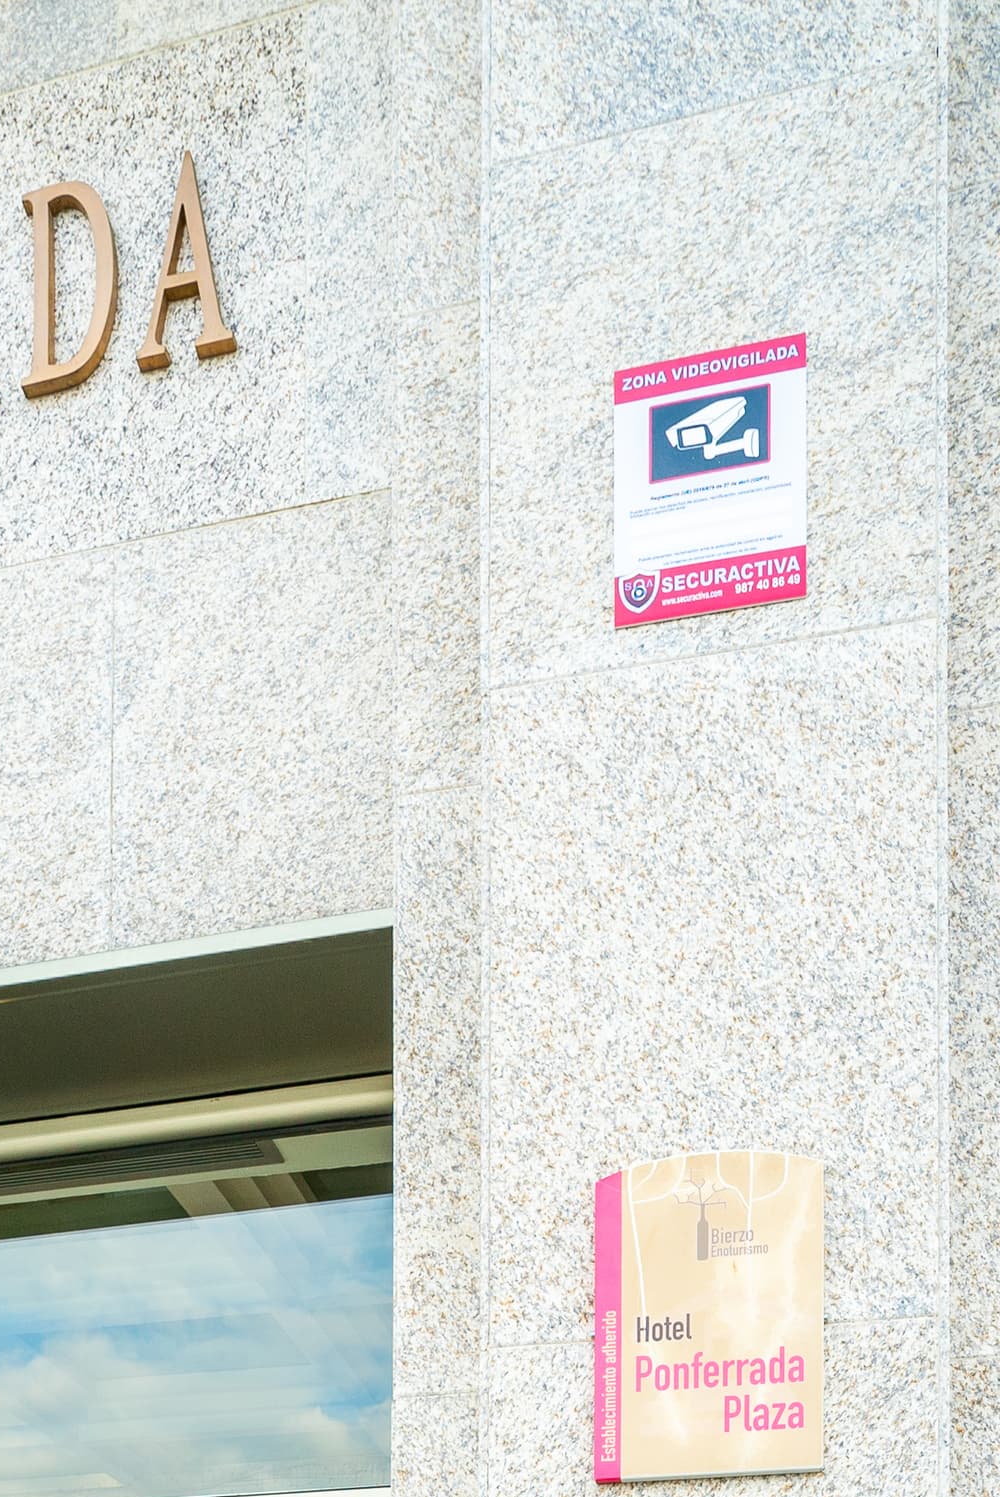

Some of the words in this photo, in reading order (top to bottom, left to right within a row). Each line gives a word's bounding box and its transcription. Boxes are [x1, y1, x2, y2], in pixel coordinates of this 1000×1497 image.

[621, 370, 667, 392] ZONA
[671, 343, 799, 381] VIDEOVIGILADA
[661, 555, 801, 593] SECURACTIVA
[734, 580, 754, 594] 987
[756, 578, 770, 592] 40
[772, 575, 785, 588] 86
[787, 573, 801, 586] 49
[661, 589, 723, 607] www.securactiva.com
[711, 1227, 754, 1244] Bierzo
[601, 1310, 617, 1363] adherido
[636, 1313, 692, 1343] Hotel
[635, 1346, 805, 1393] Ponferrada
[600, 1366, 617, 1463] Establecimiento
[724, 1394, 805, 1433] Plaza
